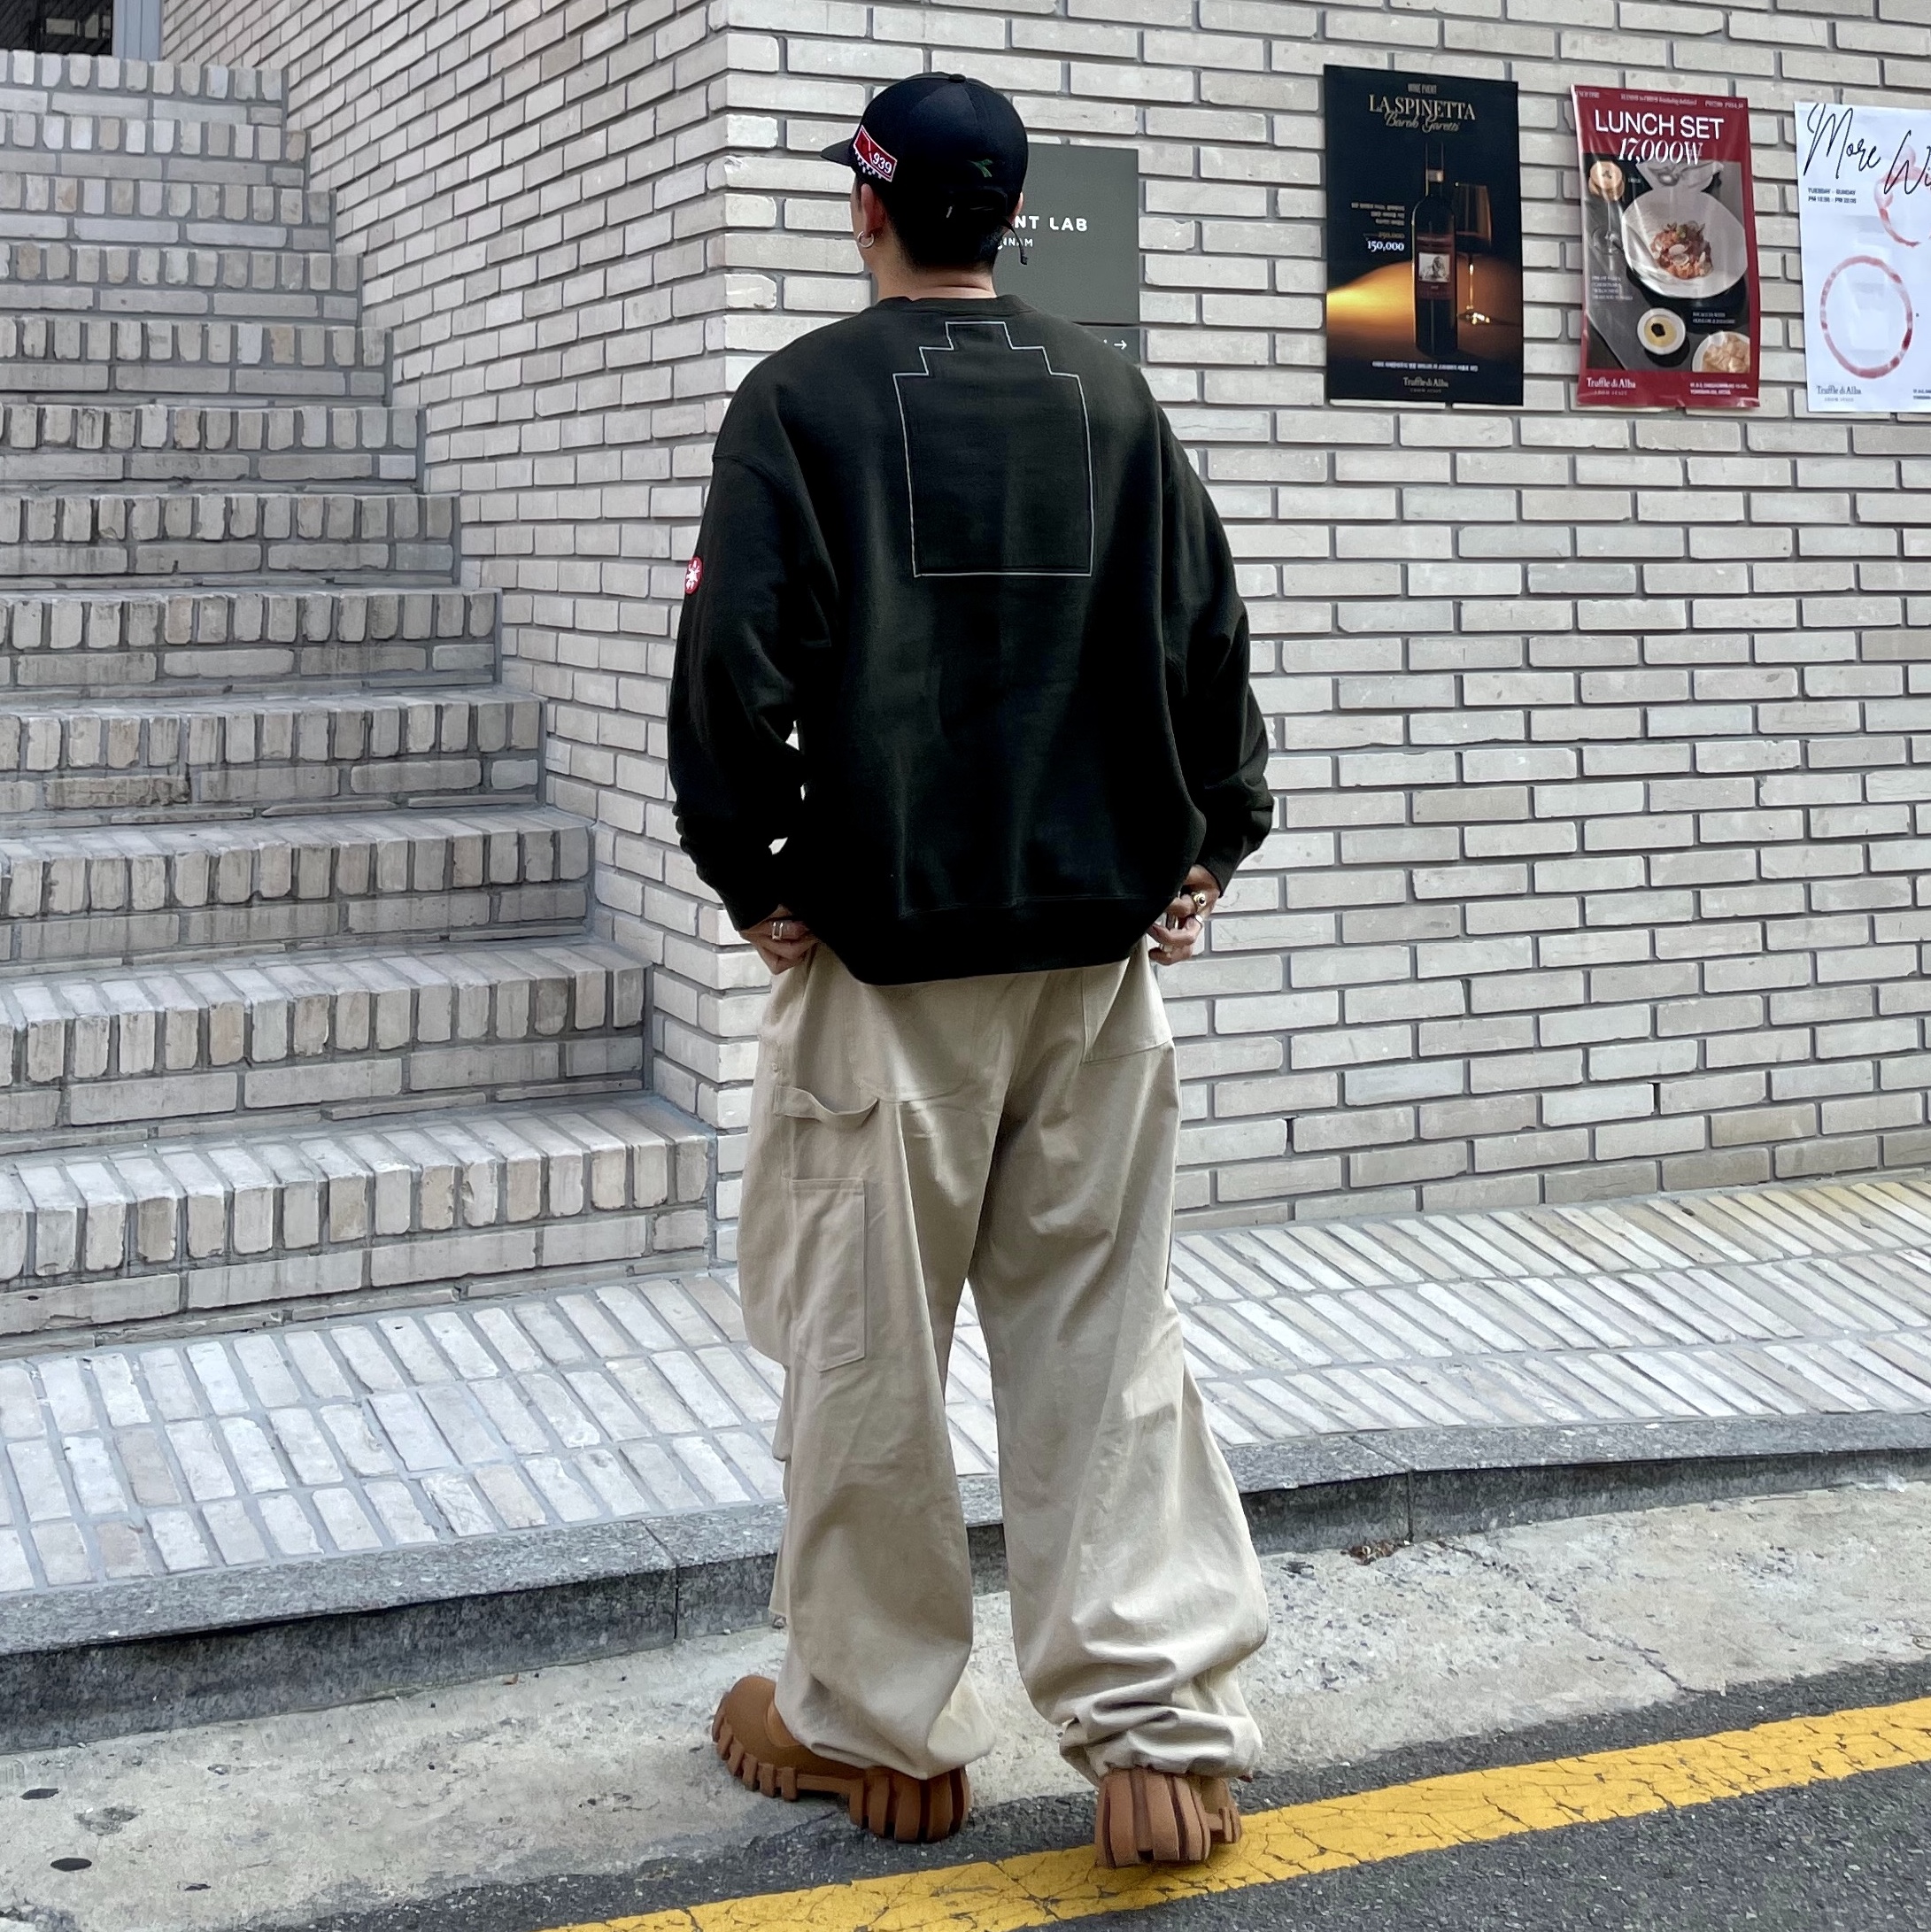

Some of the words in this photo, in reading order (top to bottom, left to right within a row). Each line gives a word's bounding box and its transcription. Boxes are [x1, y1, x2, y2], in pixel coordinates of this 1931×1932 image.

[1369, 94, 1391, 112] LA
[1394, 96, 1476, 120] SPINETTA
[1595, 109, 1674, 136] LUNCH
[1680, 115, 1725, 140] SET
[1803, 103, 1881, 180] More
[872, 152, 892, 174] 939
[1014, 215, 1039, 229] NT
[1049, 217, 1088, 232] LAB
[1367, 240, 1405, 253] 150,000
[1586, 376, 1610, 388] Truffle
[1611, 378, 1618, 388] di
[1618, 379, 1636, 389] Alba
[1816, 385, 1839, 395] Truffle
[1839, 386, 1847, 395] di
[1846, 386, 1862, 395] Alba
